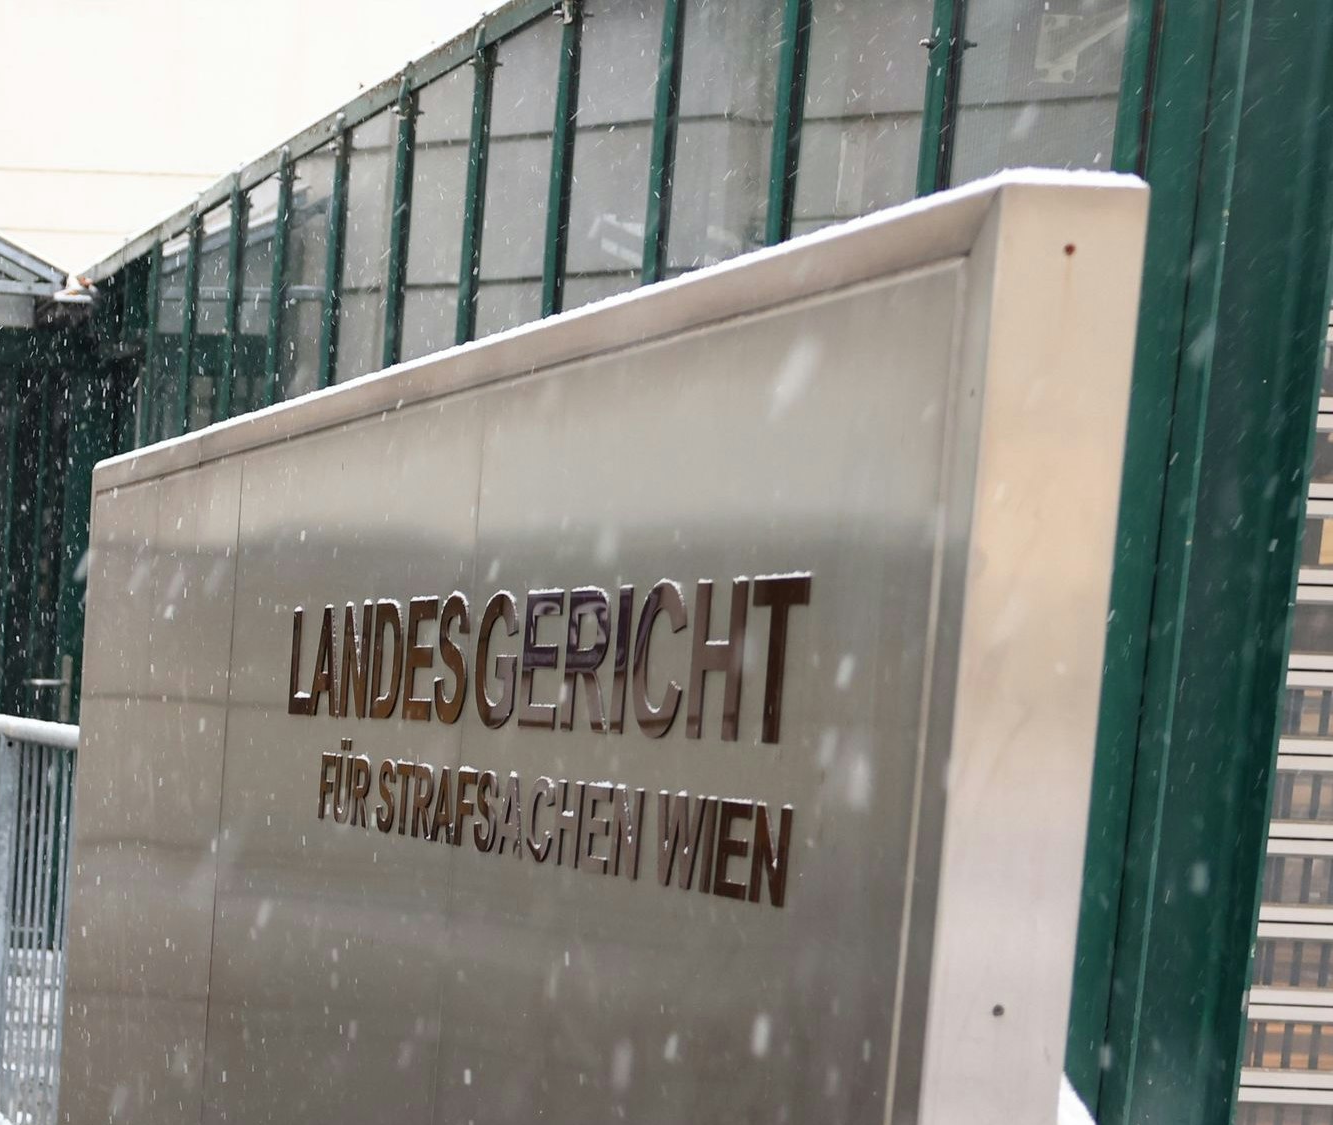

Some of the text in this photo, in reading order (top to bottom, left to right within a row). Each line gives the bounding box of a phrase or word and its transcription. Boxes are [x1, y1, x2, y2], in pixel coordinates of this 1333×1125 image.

[287, 571, 813, 744] LANDESGERICHT
[317, 737, 795, 908] FÜR STRAFSACHEN WIEN
